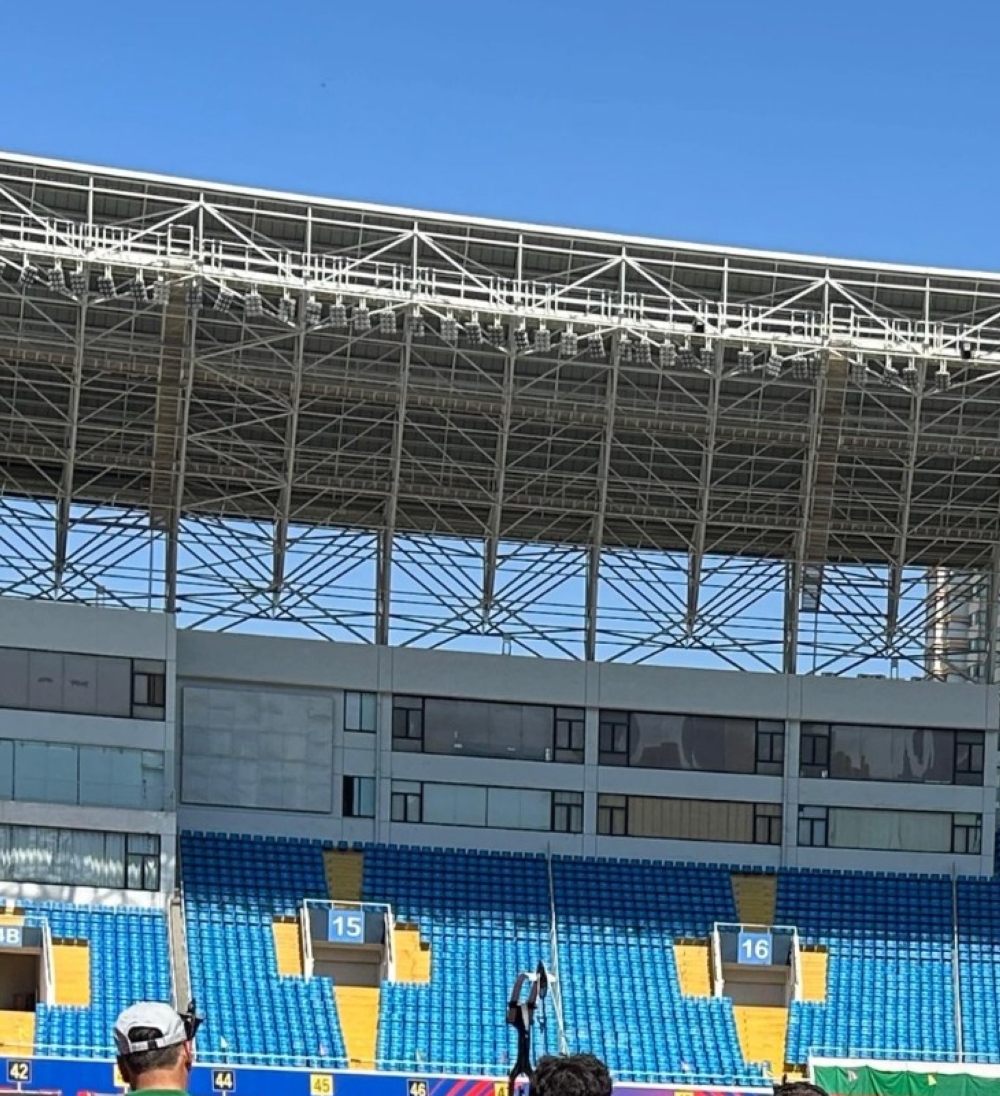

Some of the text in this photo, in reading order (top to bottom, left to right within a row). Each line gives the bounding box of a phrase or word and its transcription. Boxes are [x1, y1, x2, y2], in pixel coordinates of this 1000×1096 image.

[332, 914, 361, 937] 15
[741, 938, 770, 959] 16
[9, 1063, 29, 1079] 42
[215, 1072, 233, 1088] 44
[314, 1078, 331, 1093] 45
